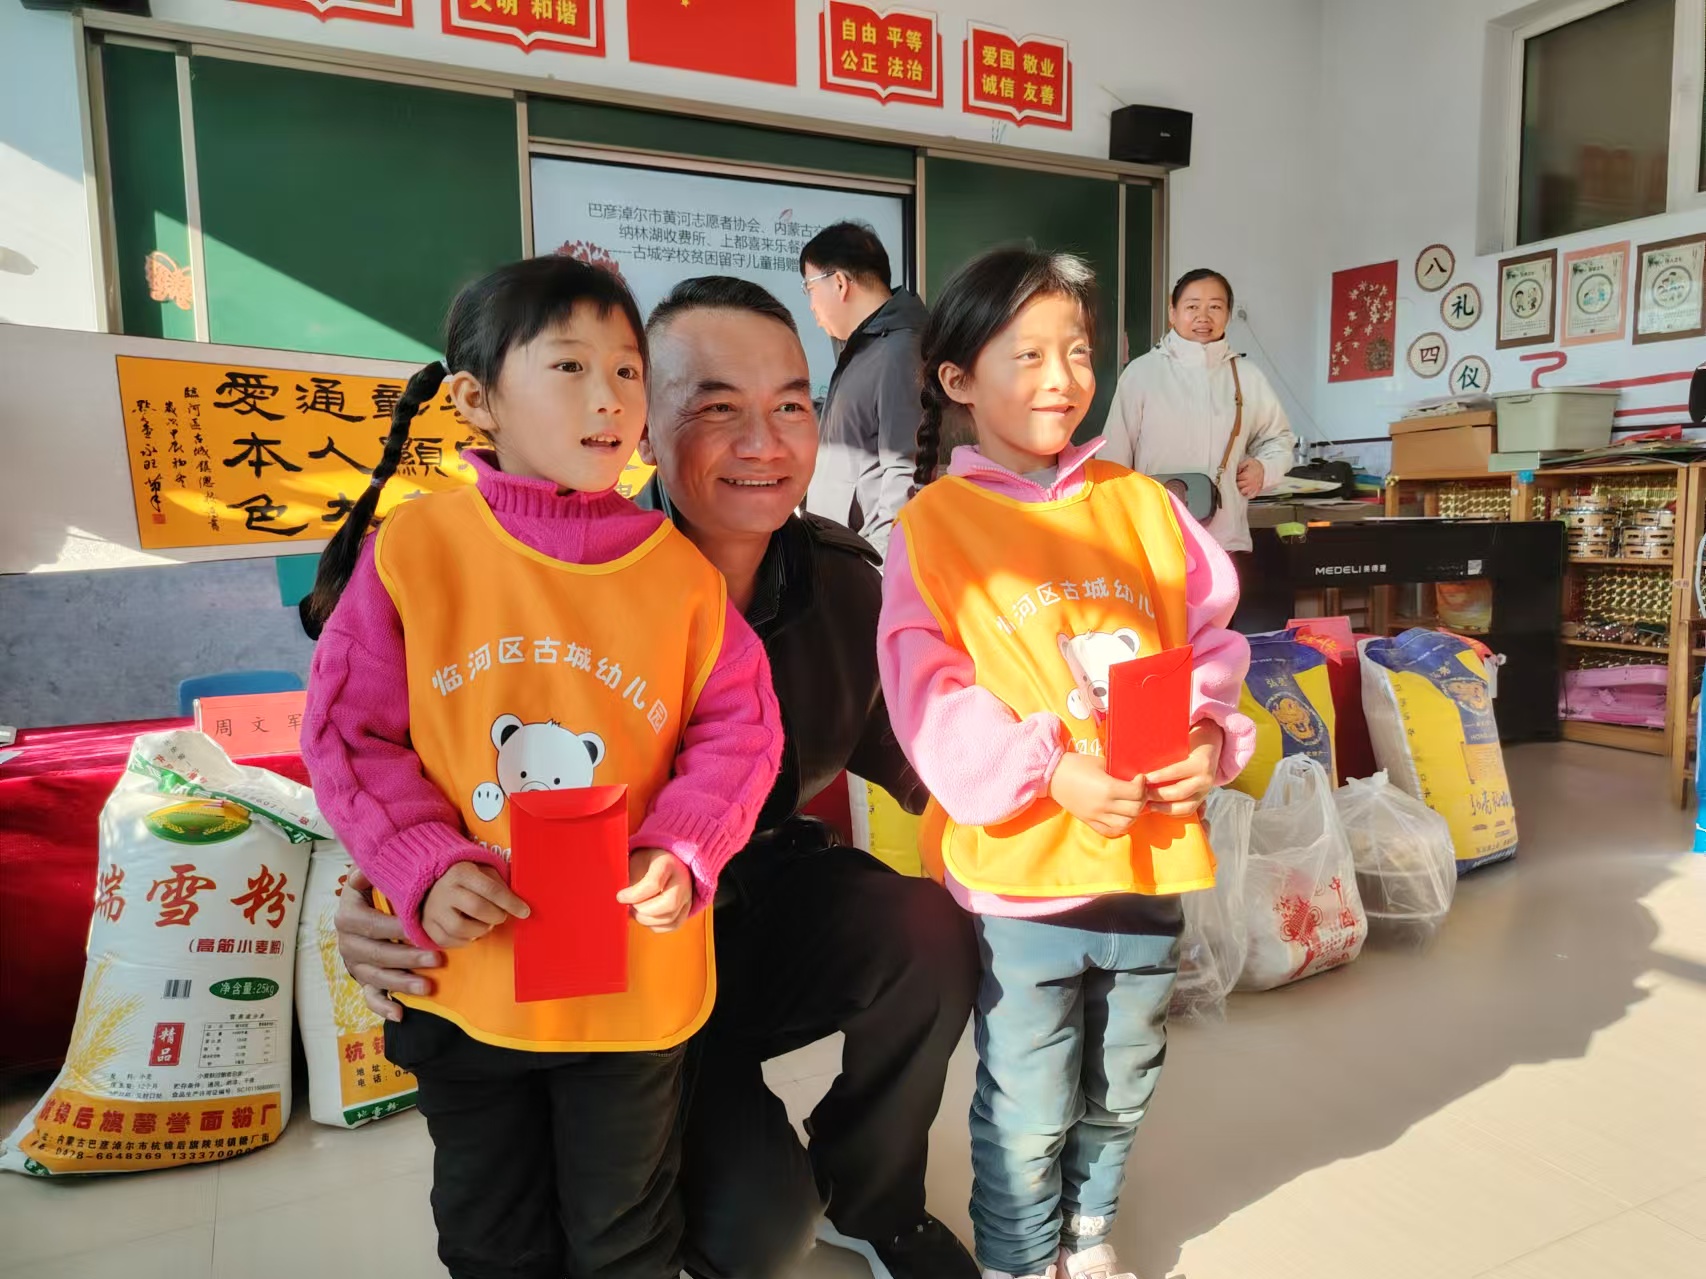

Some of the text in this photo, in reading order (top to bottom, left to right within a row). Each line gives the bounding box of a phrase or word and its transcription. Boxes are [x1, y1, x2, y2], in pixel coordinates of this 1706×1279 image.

[841, 18, 923, 53] 自由 平等
[841, 49, 923, 82] 公正 法治
[982, 45, 1055, 79] 爱国 敬业
[982, 74, 1055, 107] 诚信 友善
[1424, 257, 1447, 277] 八
[1451, 295, 1475, 319] 礼
[1420, 344, 1440, 365] 四
[1457, 365, 1483, 390] 仪
[1315, 565, 1361, 575] MEDELI
[431, 636, 668, 735] 临河区古城幼儿园
[219, 981, 275, 996] 净含量:25kg
[157, 1026, 177, 1062] 精品
